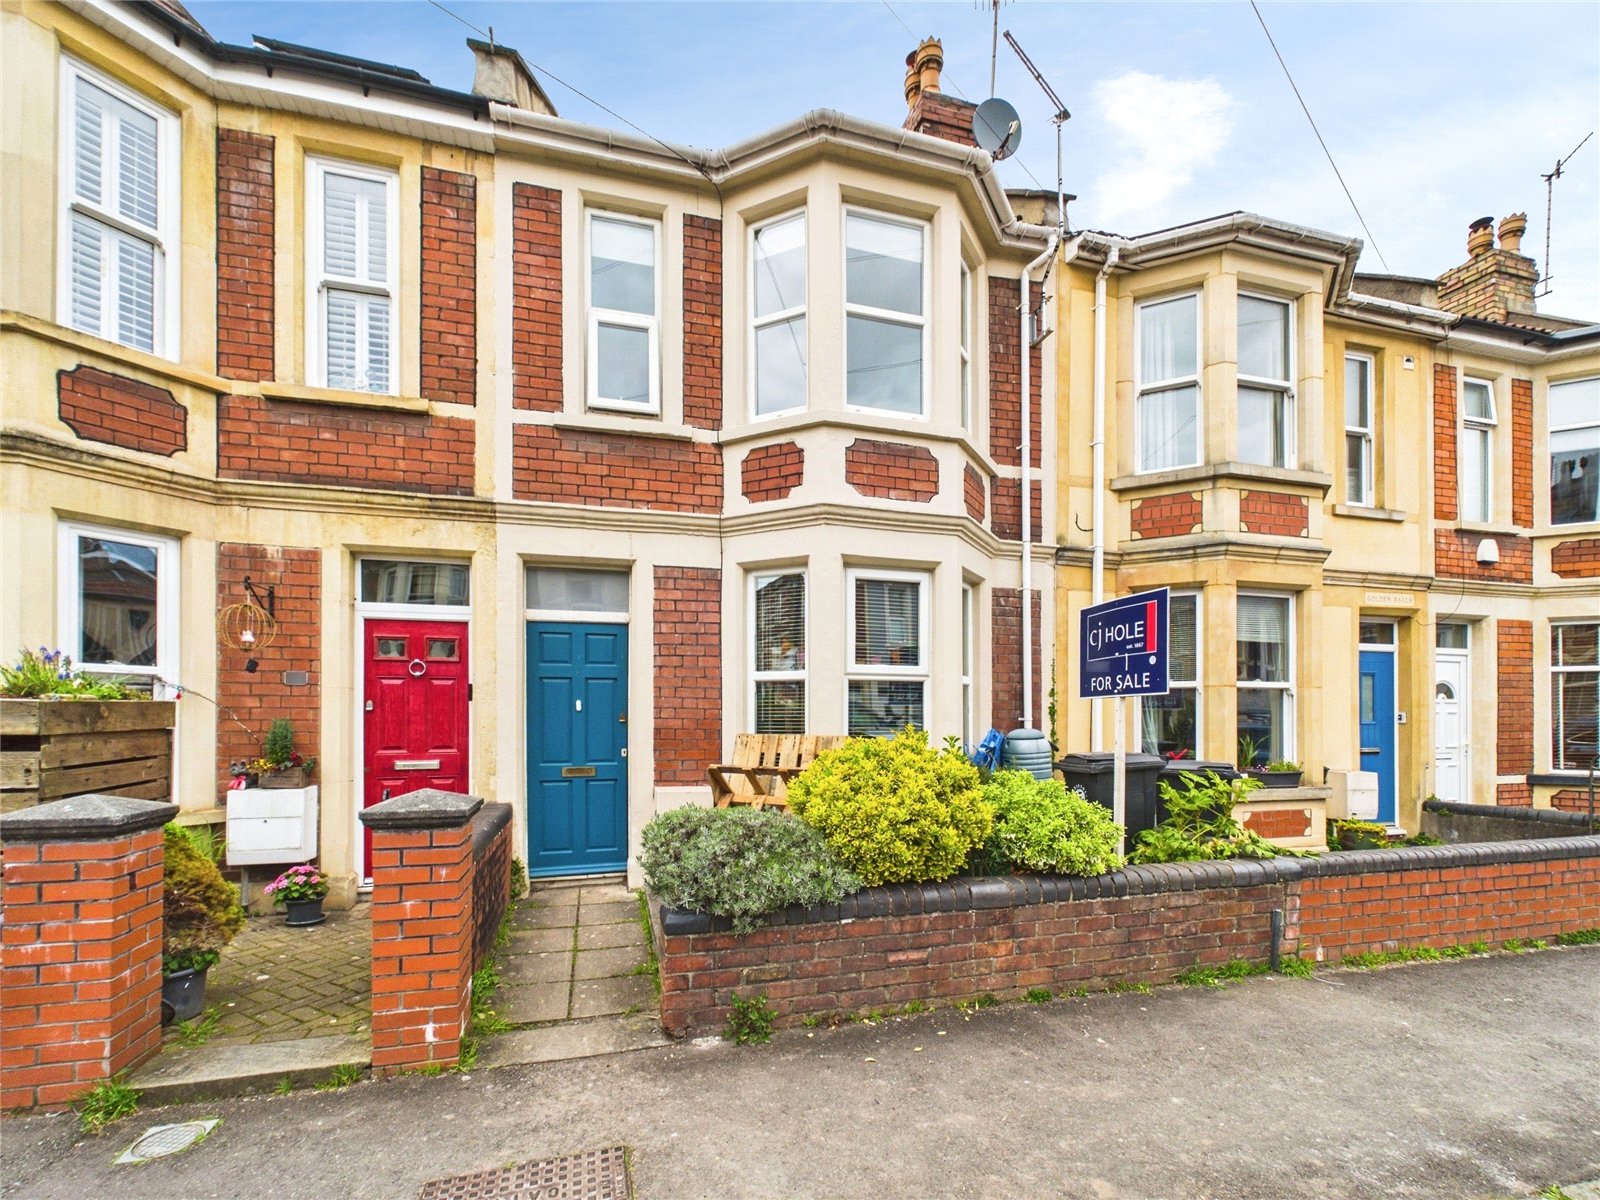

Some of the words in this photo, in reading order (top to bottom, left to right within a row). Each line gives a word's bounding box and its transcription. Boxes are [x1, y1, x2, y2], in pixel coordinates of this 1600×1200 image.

[1105, 621, 1144, 642] HOLE
[1091, 676, 1112, 691] FOR
[1116, 672, 1150, 689] SALE
